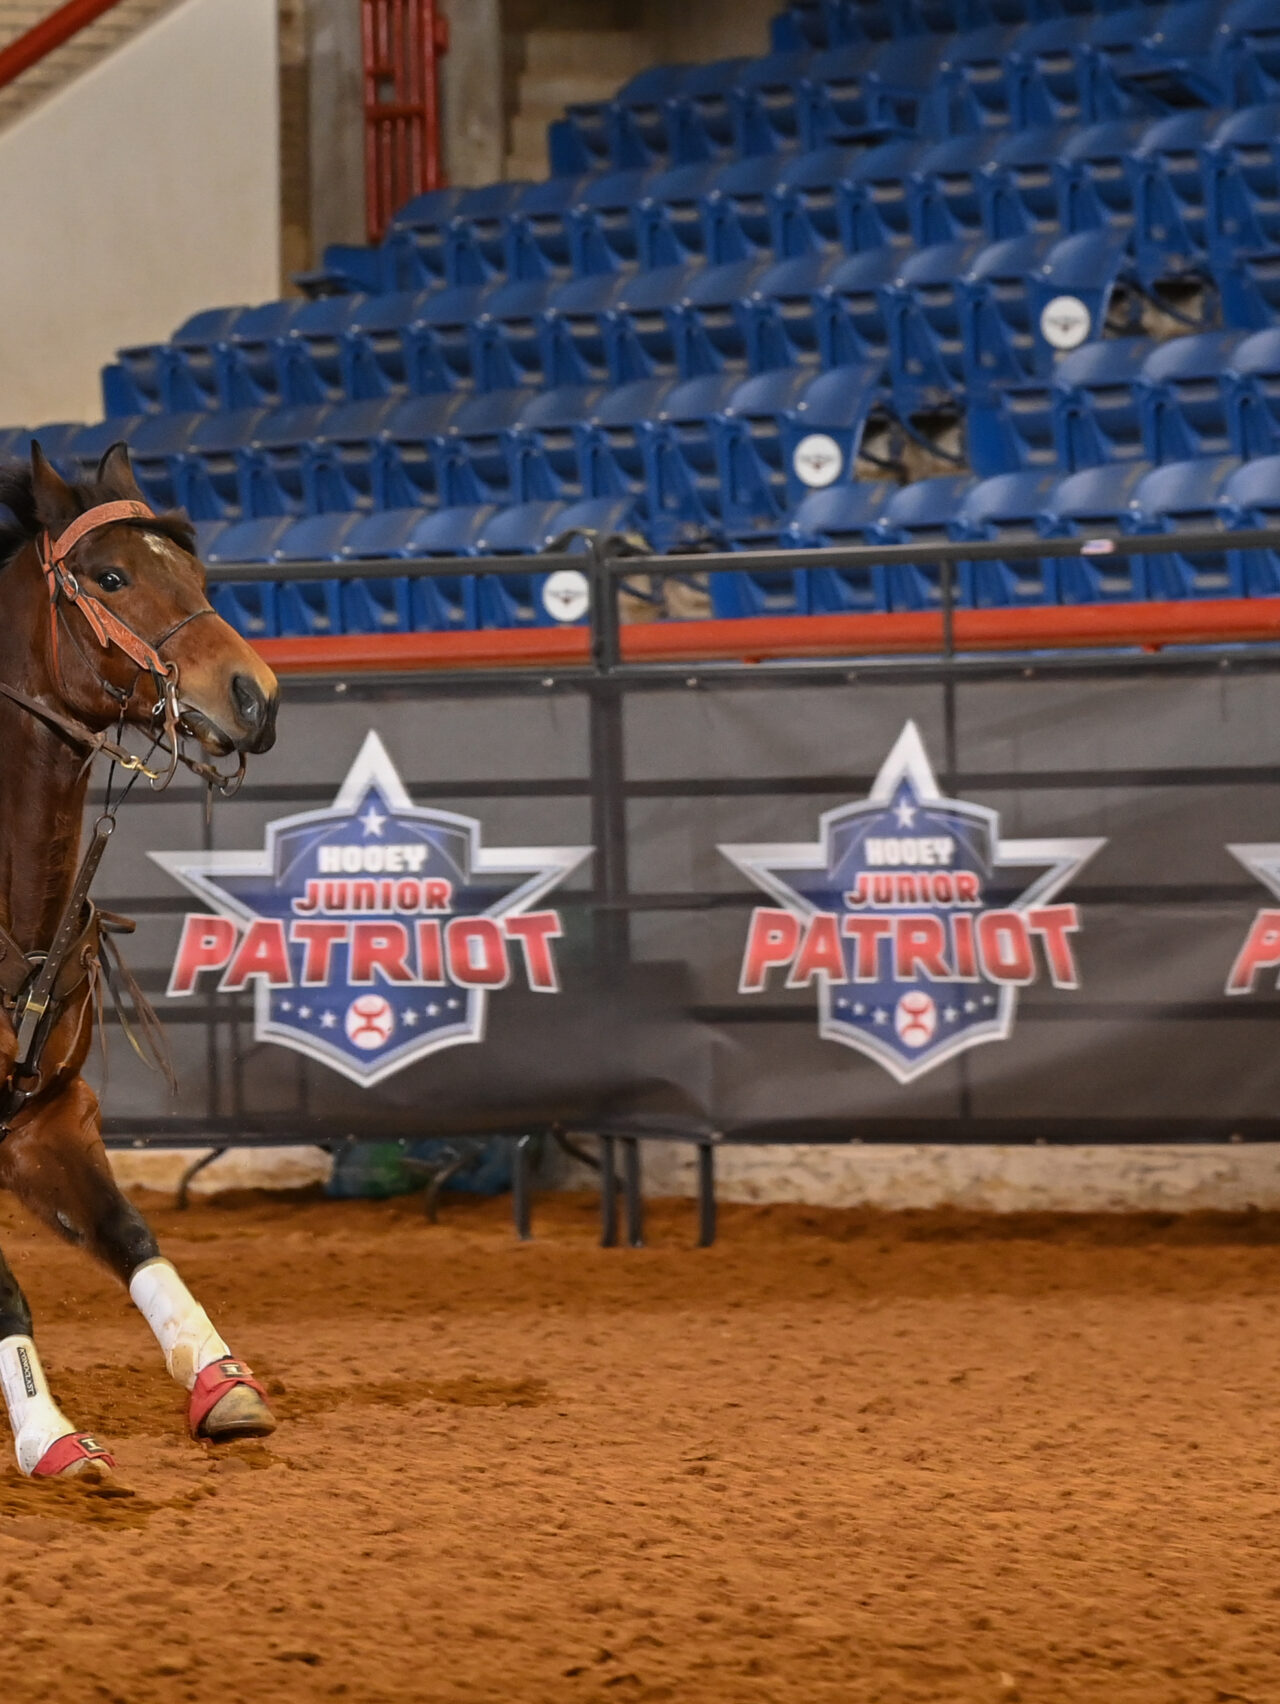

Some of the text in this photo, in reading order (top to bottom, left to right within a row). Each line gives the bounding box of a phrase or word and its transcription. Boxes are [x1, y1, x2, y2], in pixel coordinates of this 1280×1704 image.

[318, 845, 428, 874] HOOEY
[865, 837, 955, 866] HOOEY
[291, 877, 452, 916] JUNIOR
[843, 870, 983, 909] JUNIOR
[166, 910, 564, 997] PATRIOT
[738, 904, 1082, 994] PATRIOT
